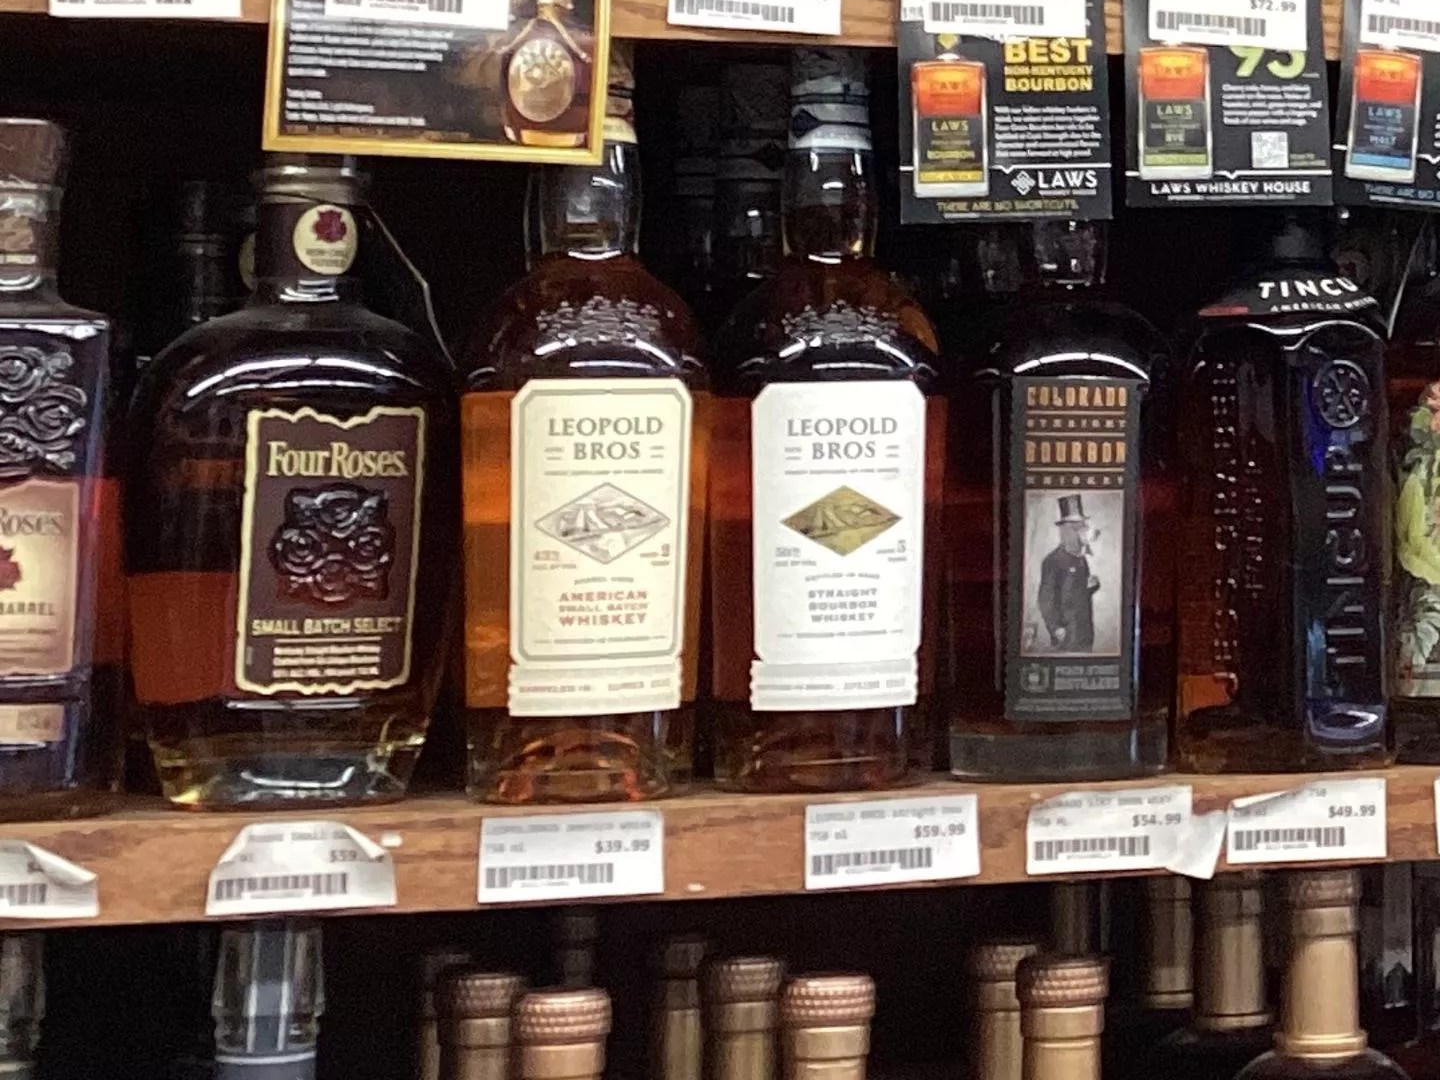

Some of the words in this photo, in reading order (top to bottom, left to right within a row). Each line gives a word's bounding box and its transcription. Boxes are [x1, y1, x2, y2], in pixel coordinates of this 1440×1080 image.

[1250, 0, 1296, 12] $72.99
[1004, 38, 1092, 63] BEST
[1005, 77, 1093, 91] BOURBON
[1039, 171, 1097, 188] LAWS
[1151, 182, 1191, 193] LAWS
[1196, 182, 1258, 193] WHISKEY
[1264, 181, 1310, 192] HOUSE
[1258, 277, 1360, 300] TINCU
[1026, 386, 1128, 407] COLORADO
[548, 416, 663, 437] LEOPOLD
[787, 416, 898, 437] LEOPOLD
[266, 441, 332, 477] Four
[330, 442, 408, 477] Roses
[573, 441, 641, 460] BROS
[811, 441, 876, 460] BROS
[1024, 440, 1126, 464] BOURBON
[559, 591, 648, 602] AMERICAN
[251, 618, 299, 637] SMALL
[303, 619, 352, 636] BATCH
[354, 617, 401, 635] SELECT
[559, 614, 646, 627] WHISKEY
[1328, 804, 1376, 819] $49.99
[1132, 814, 1181, 828] $54.99
[913, 824, 965, 839] $59.99
[594, 838, 651, 855] $39.99
